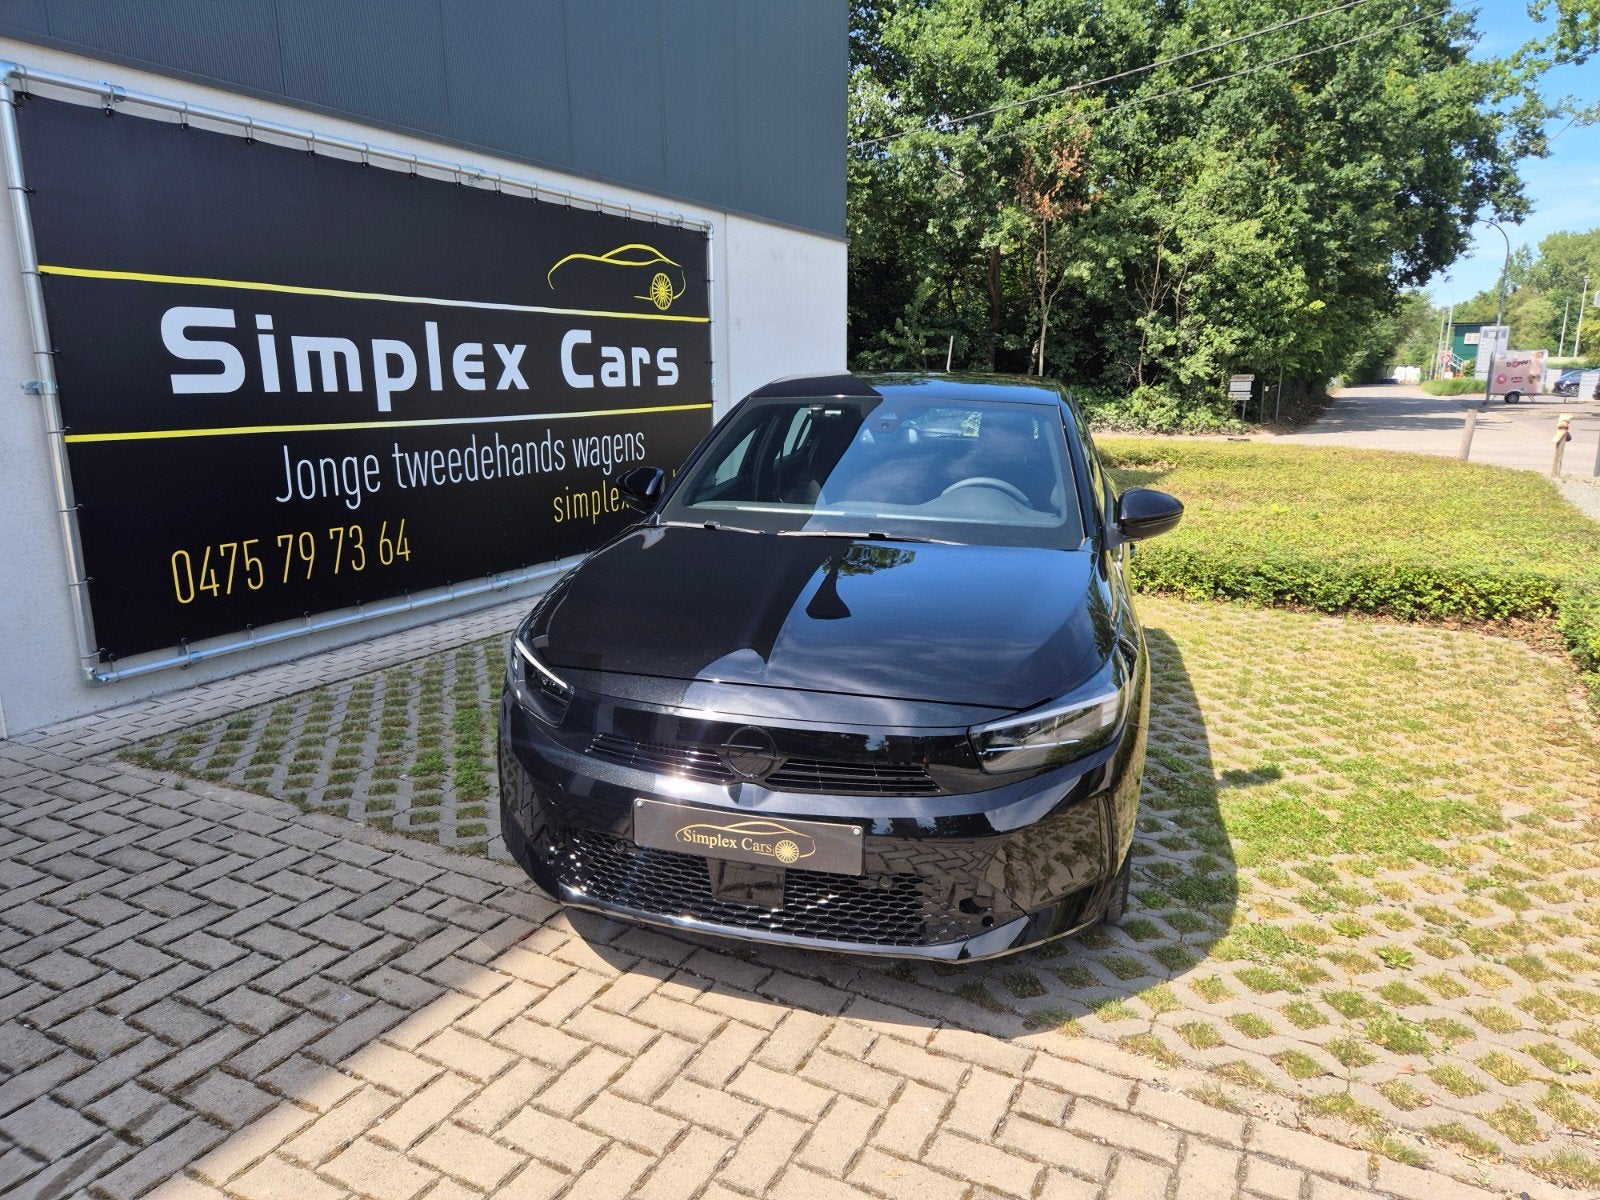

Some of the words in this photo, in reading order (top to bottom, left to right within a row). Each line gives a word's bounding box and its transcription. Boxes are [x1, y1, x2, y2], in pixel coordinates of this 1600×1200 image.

[161, 306, 530, 412] Simplex
[560, 329, 679, 389] Cars
[276, 445, 381, 509] Jonge
[392, 429, 565, 488] tweedehands
[573, 431, 645, 475] wagens
[171, 539, 264, 604] 0475
[277, 531, 315, 584] 79
[329, 525, 366, 574] 73
[379, 518, 411, 566] 64
[683, 829, 738, 849] Simplex
[741, 837, 773, 853] Cars
